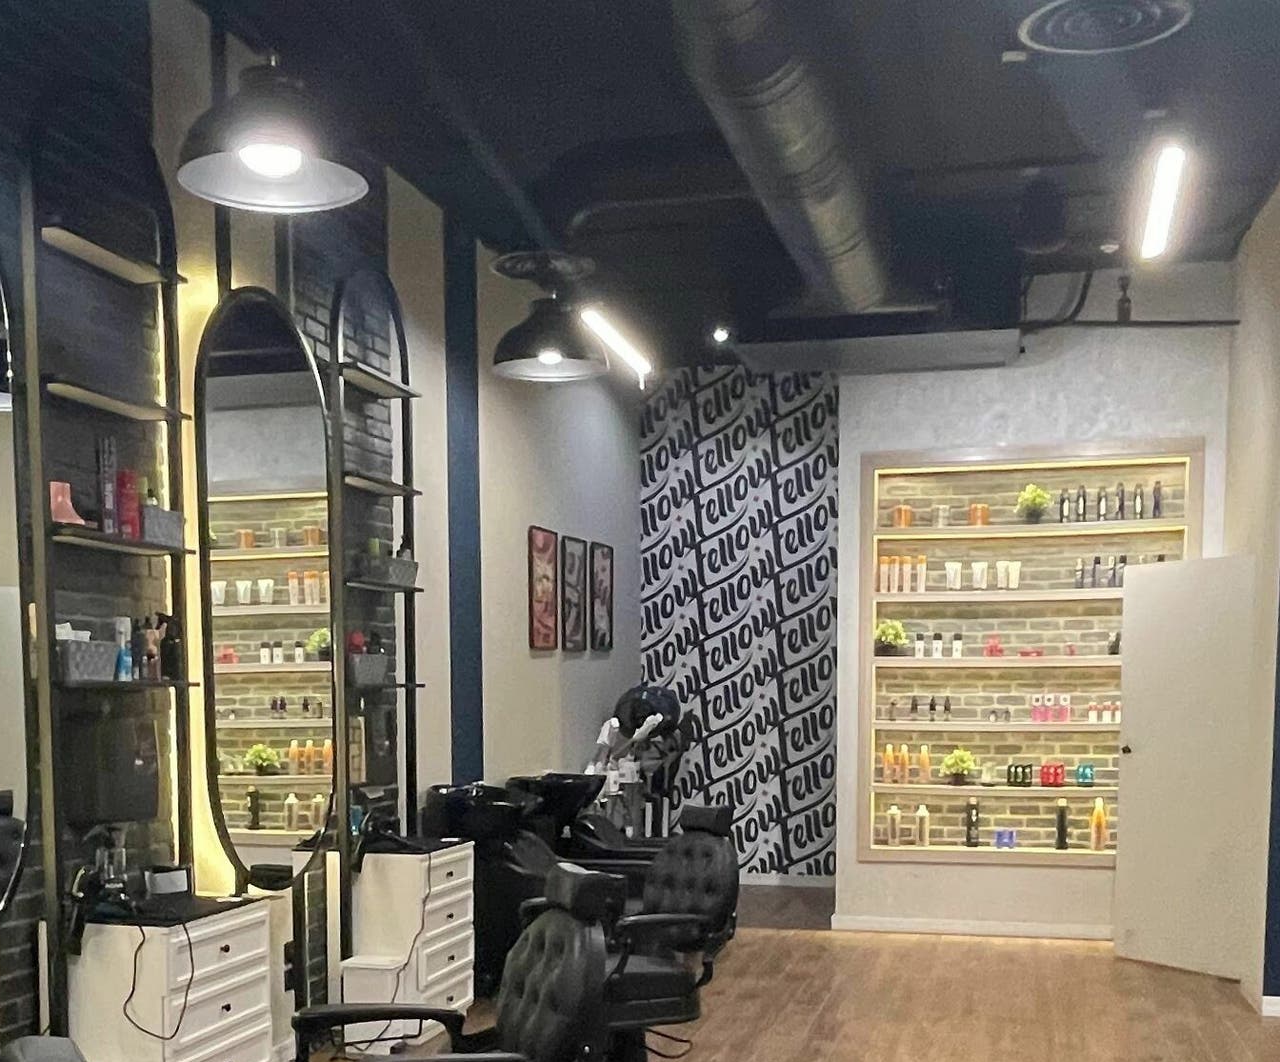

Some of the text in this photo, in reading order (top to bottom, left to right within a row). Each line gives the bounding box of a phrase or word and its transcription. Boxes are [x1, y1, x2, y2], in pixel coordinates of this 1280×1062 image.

[765, 597, 837, 667] Fello
[766, 647, 837, 716] Fello
[768, 696, 837, 766] Fello
[768, 752, 837, 814] Fello
[770, 800, 837, 863] Fello
